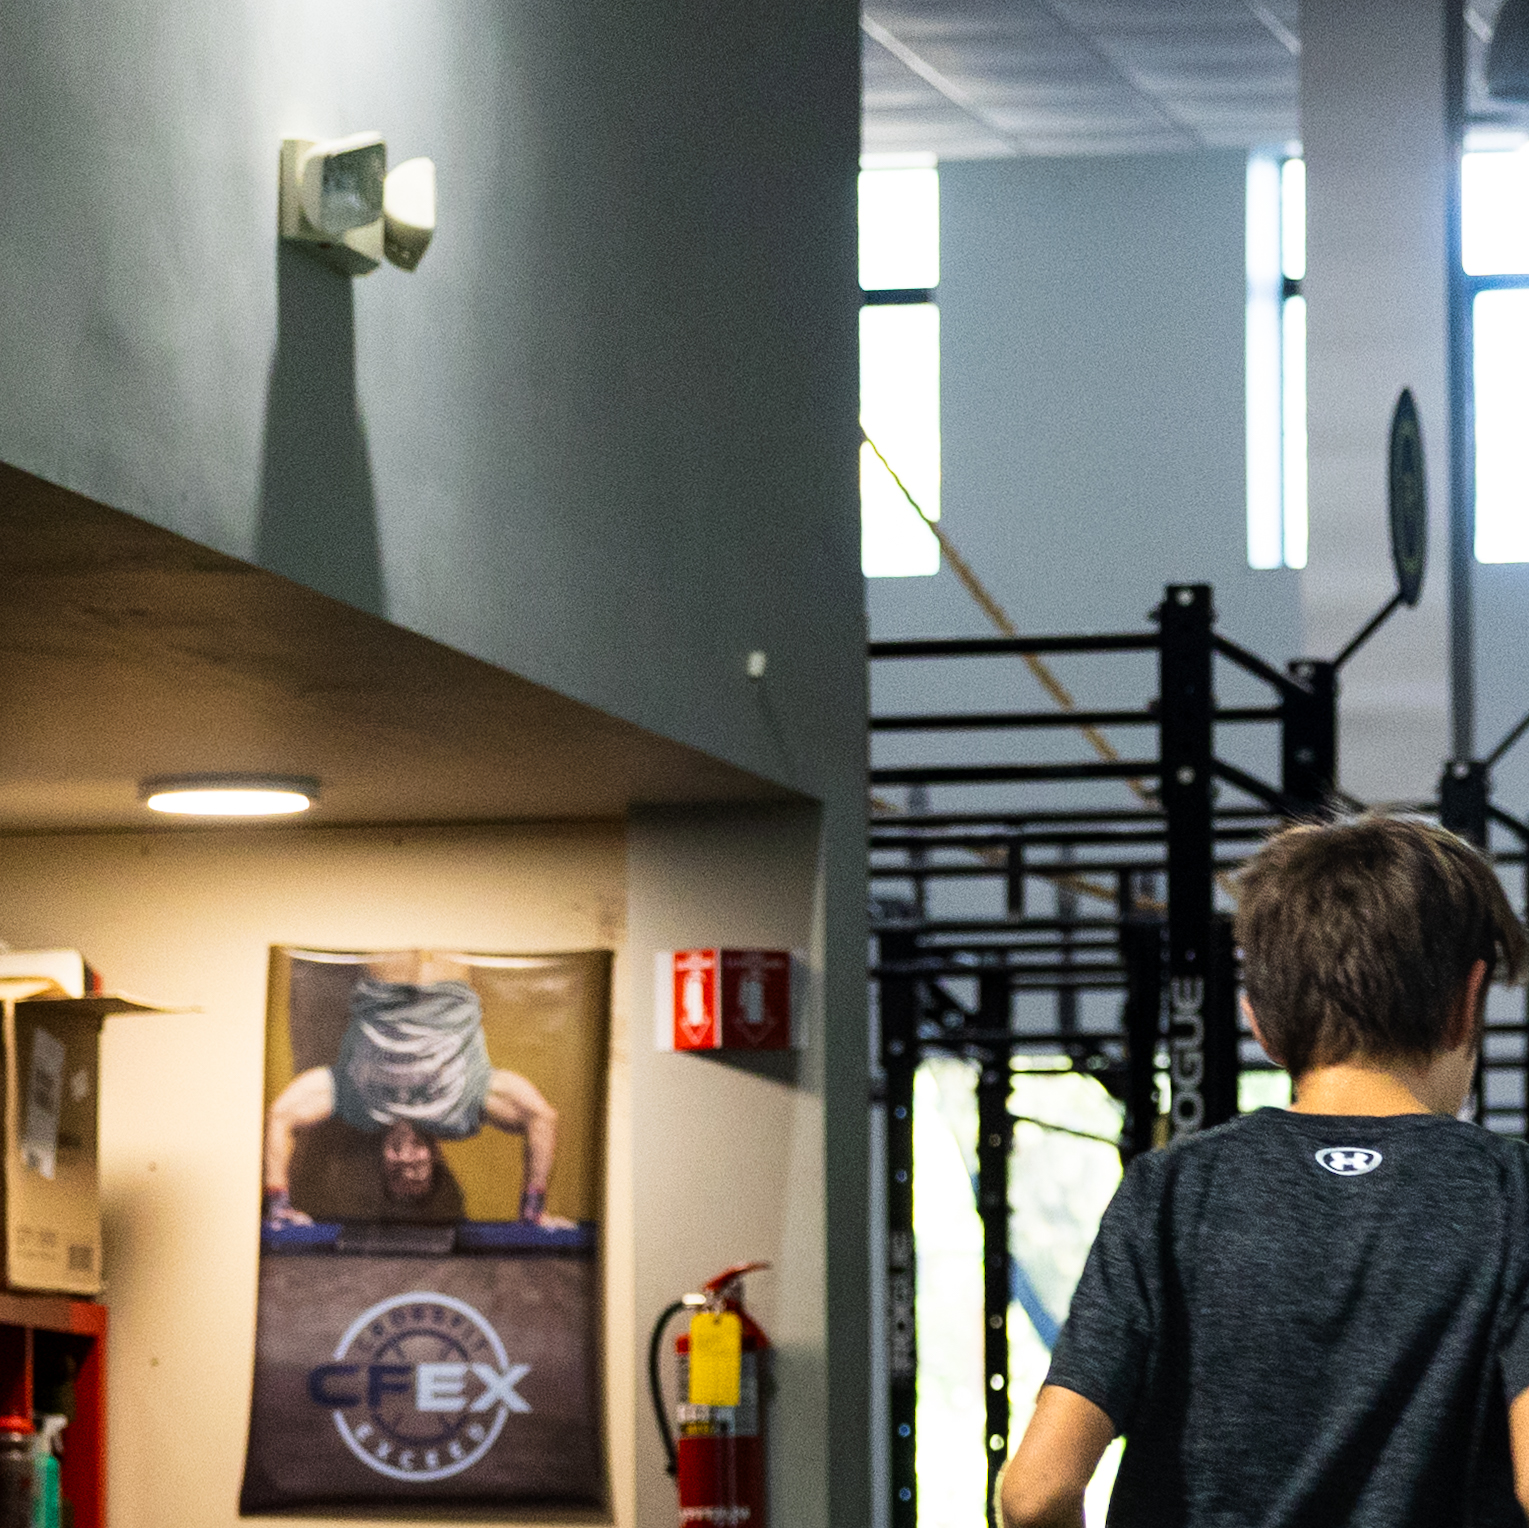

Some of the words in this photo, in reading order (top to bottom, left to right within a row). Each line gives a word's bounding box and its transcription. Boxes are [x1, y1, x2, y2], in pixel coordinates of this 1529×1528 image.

[1172, 976, 1204, 1135] OGUE
[308, 1362, 534, 1414] CFEX
[355, 1422, 487, 1470] EXCEED
